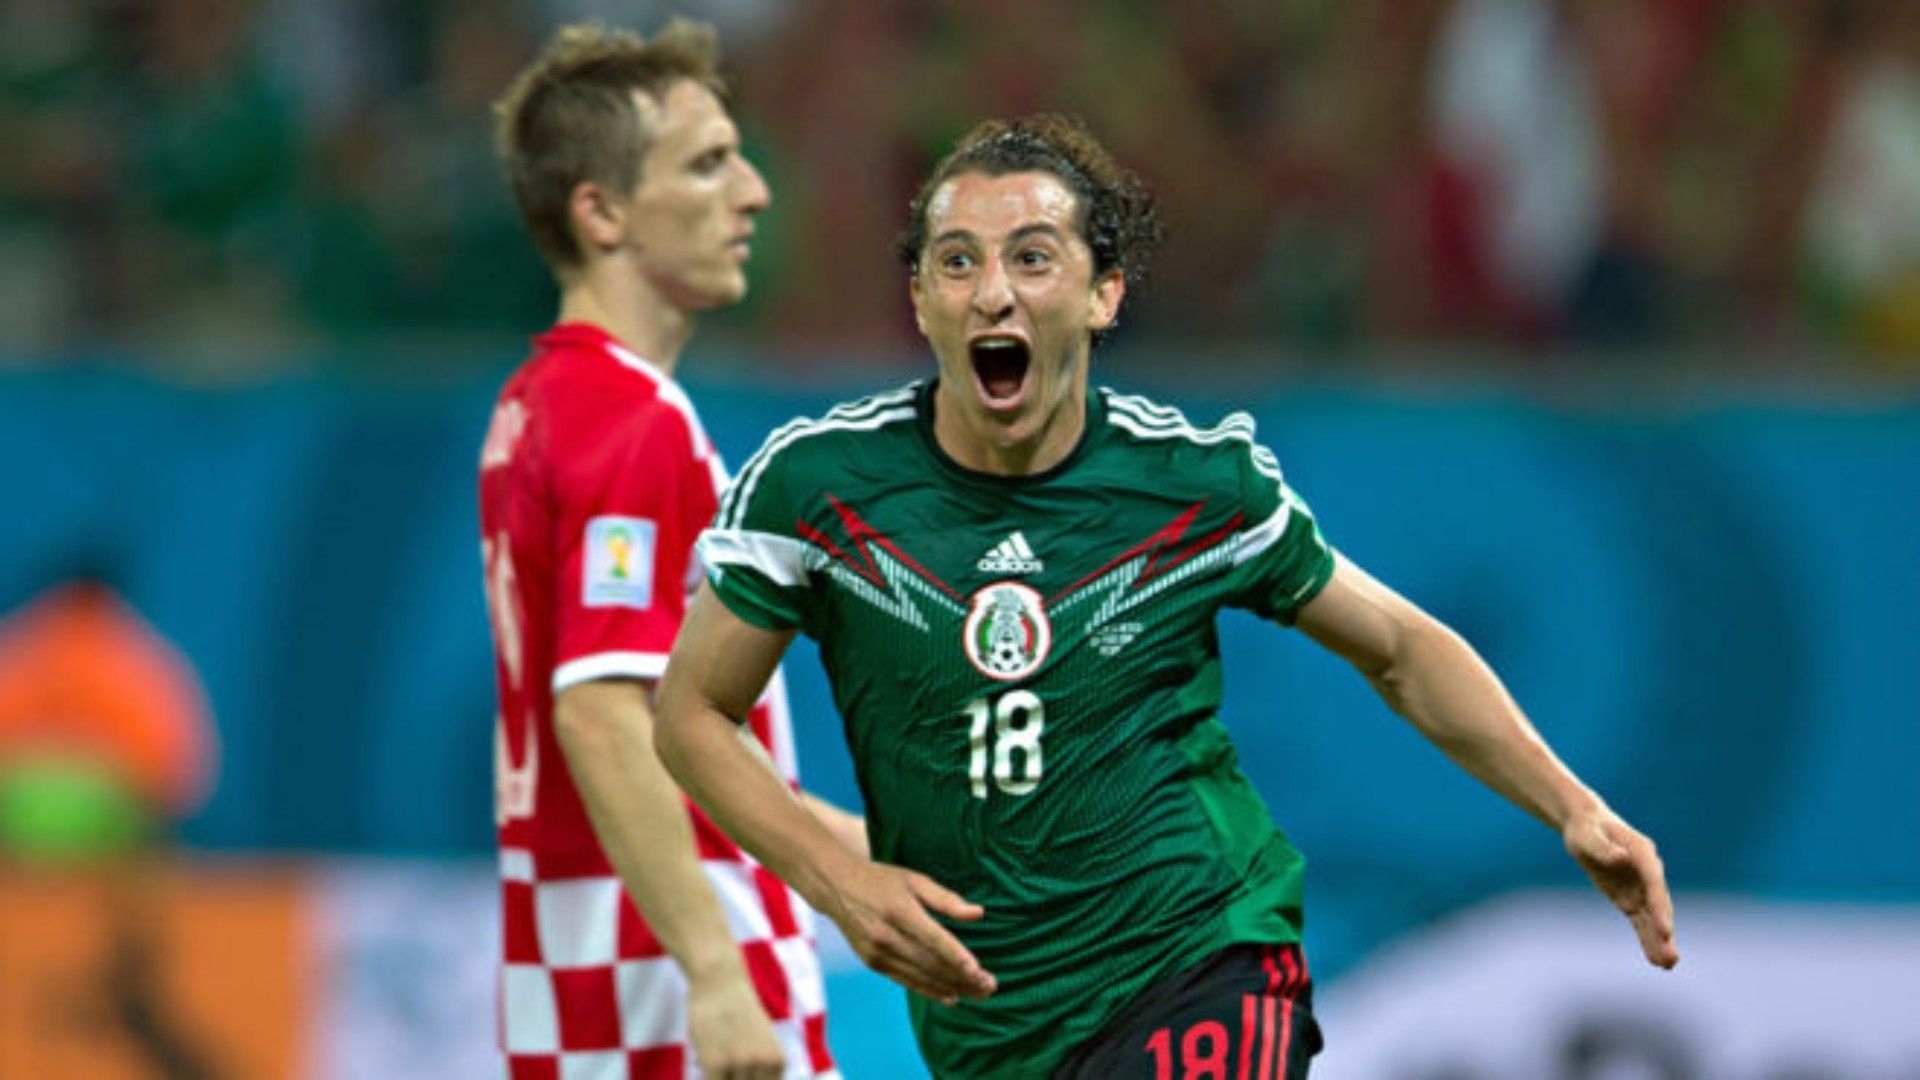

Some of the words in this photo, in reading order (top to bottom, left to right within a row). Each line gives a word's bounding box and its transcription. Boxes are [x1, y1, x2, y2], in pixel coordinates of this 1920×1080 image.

[977, 557, 1043, 574] adidas
[962, 689, 1043, 798] 18
[1145, 1019, 1229, 1080] 18
